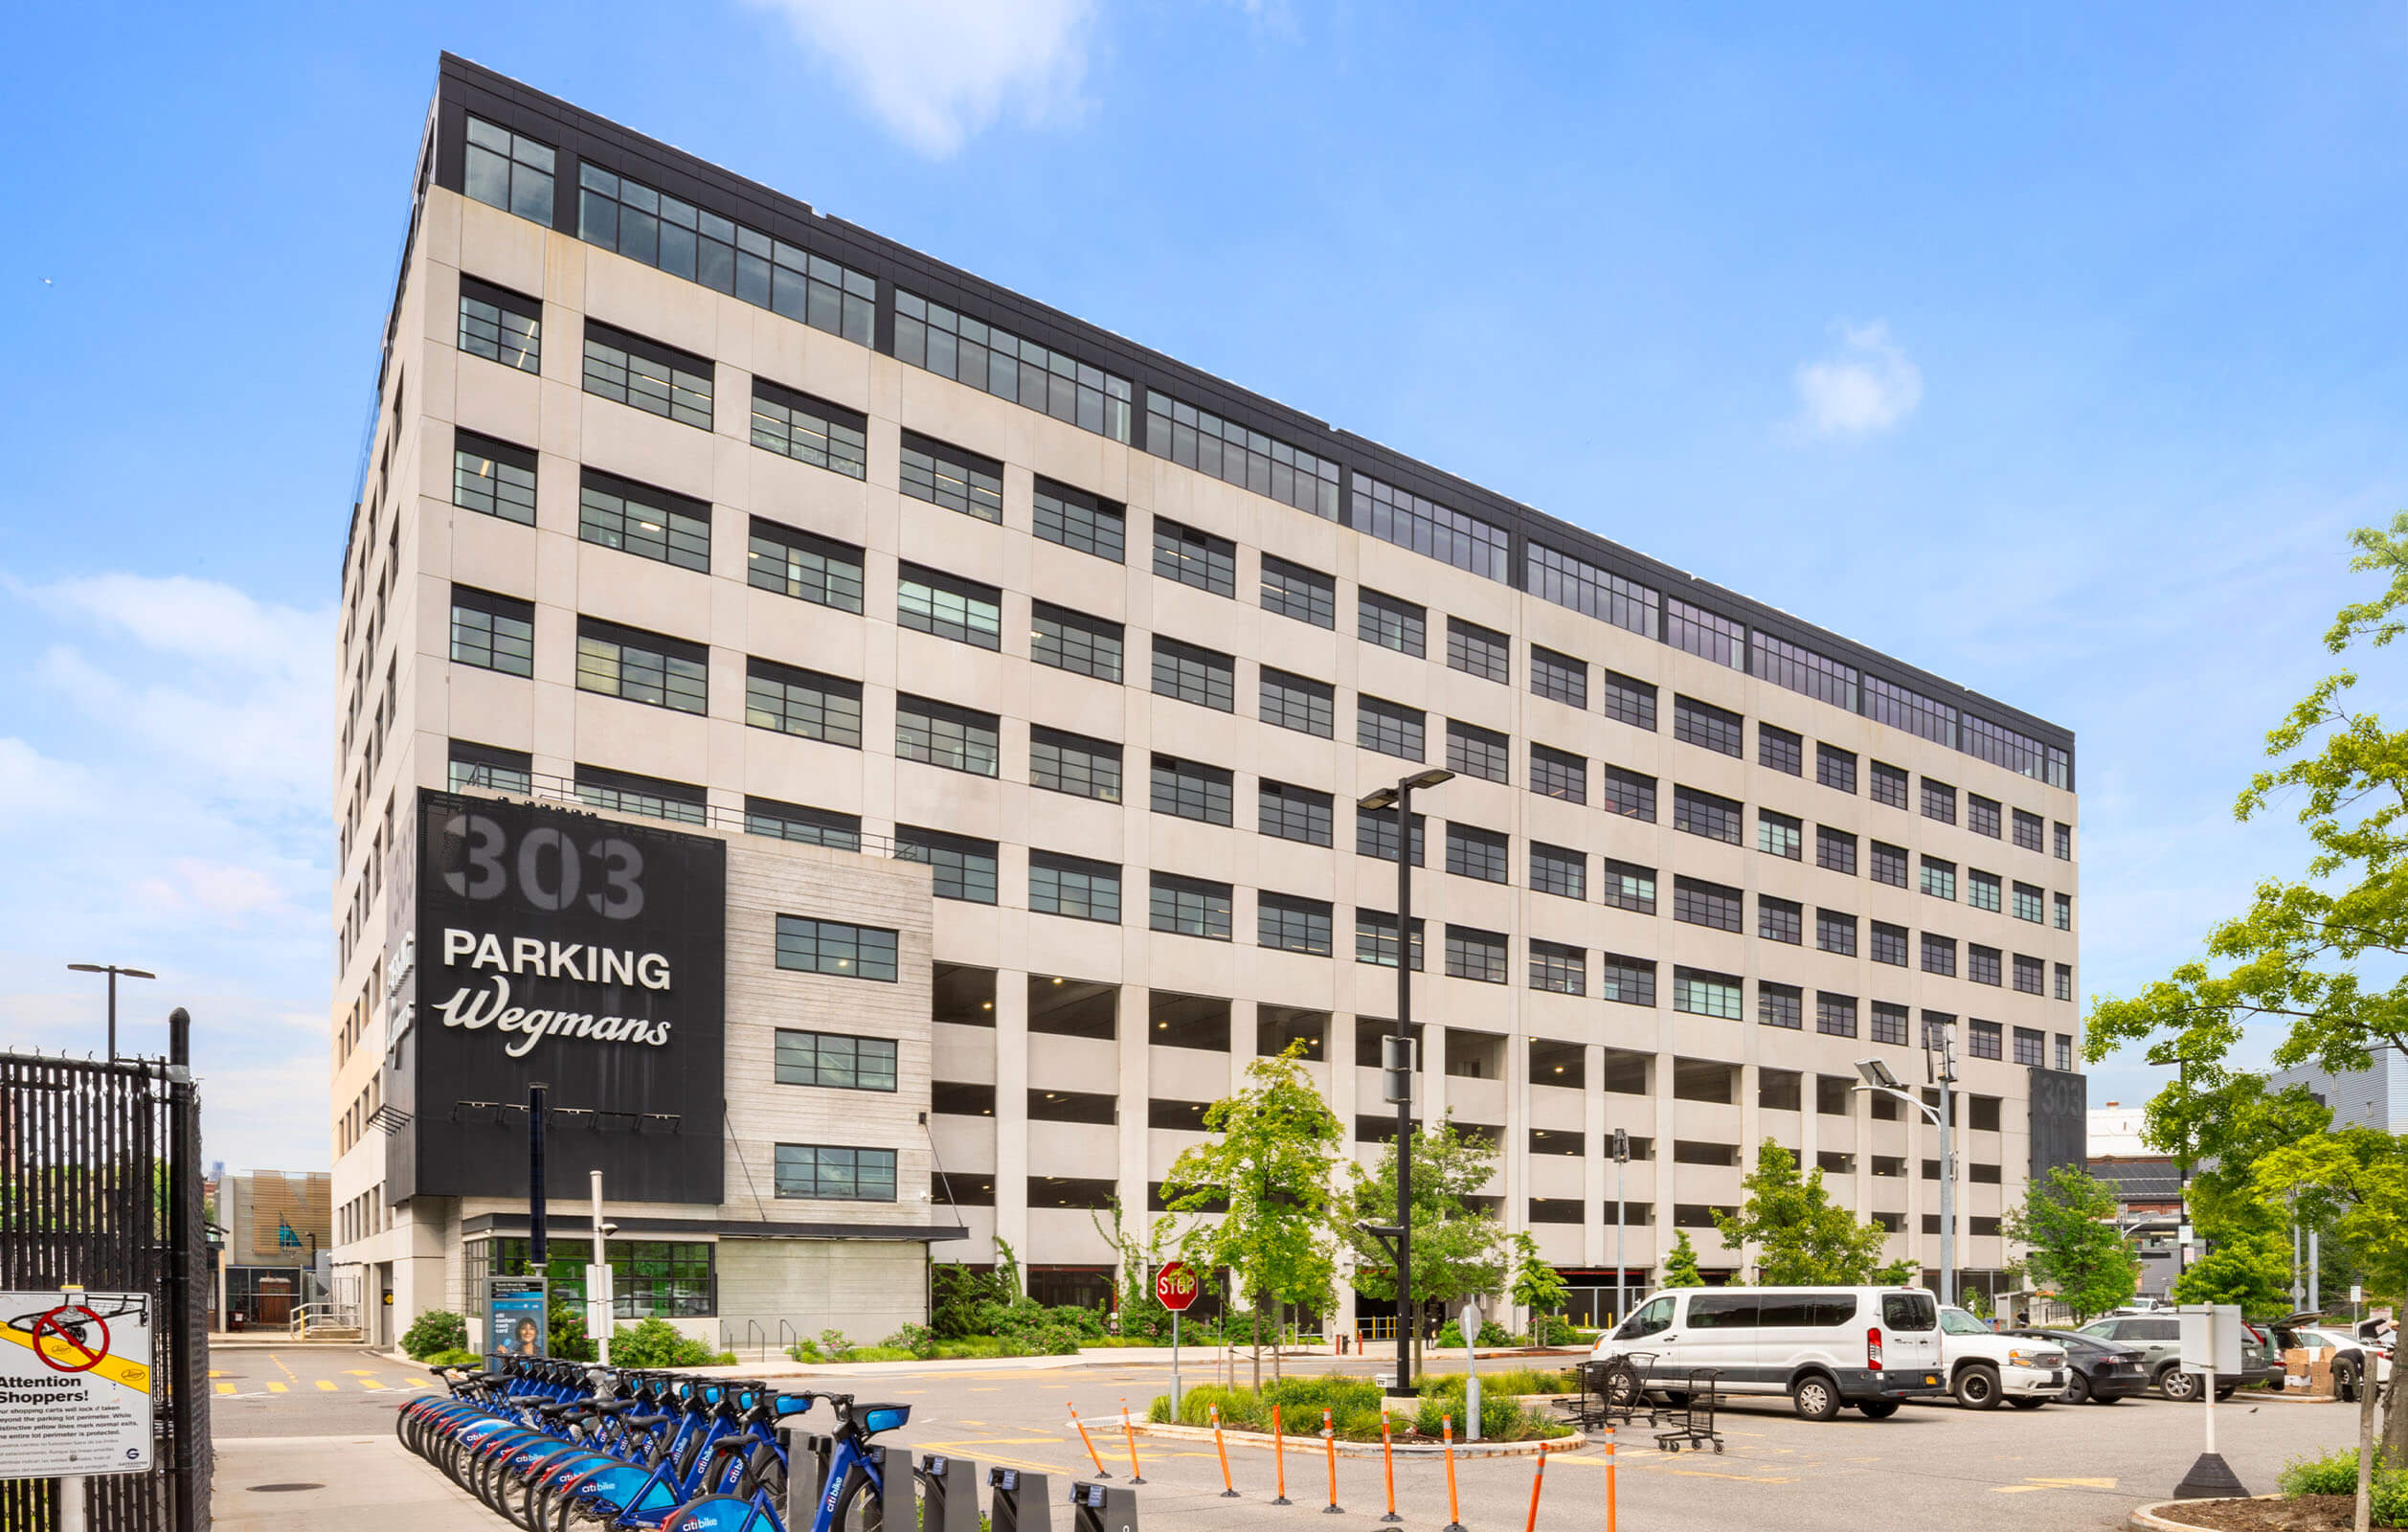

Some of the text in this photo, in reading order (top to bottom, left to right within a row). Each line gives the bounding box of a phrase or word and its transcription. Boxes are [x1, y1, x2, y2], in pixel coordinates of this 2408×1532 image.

[443, 814, 644, 920] 303
[444, 927, 671, 990] PARKING
[431, 975, 671, 1057] Wegmans
[2041, 1076, 2084, 1117] 303
[1159, 1276, 1195, 1295] STOP
[0, 1376, 81, 1387] Attention
[0, 1389, 88, 1406] Shoppers!
[516, 1453, 529, 1462] citi
[698, 1460, 709, 1475] citi
[730, 1469, 741, 1483] citi
[582, 1481, 616, 1493] citi bike
[827, 1476, 843, 1513] citi bike
[683, 1517, 718, 1532] citi bike
